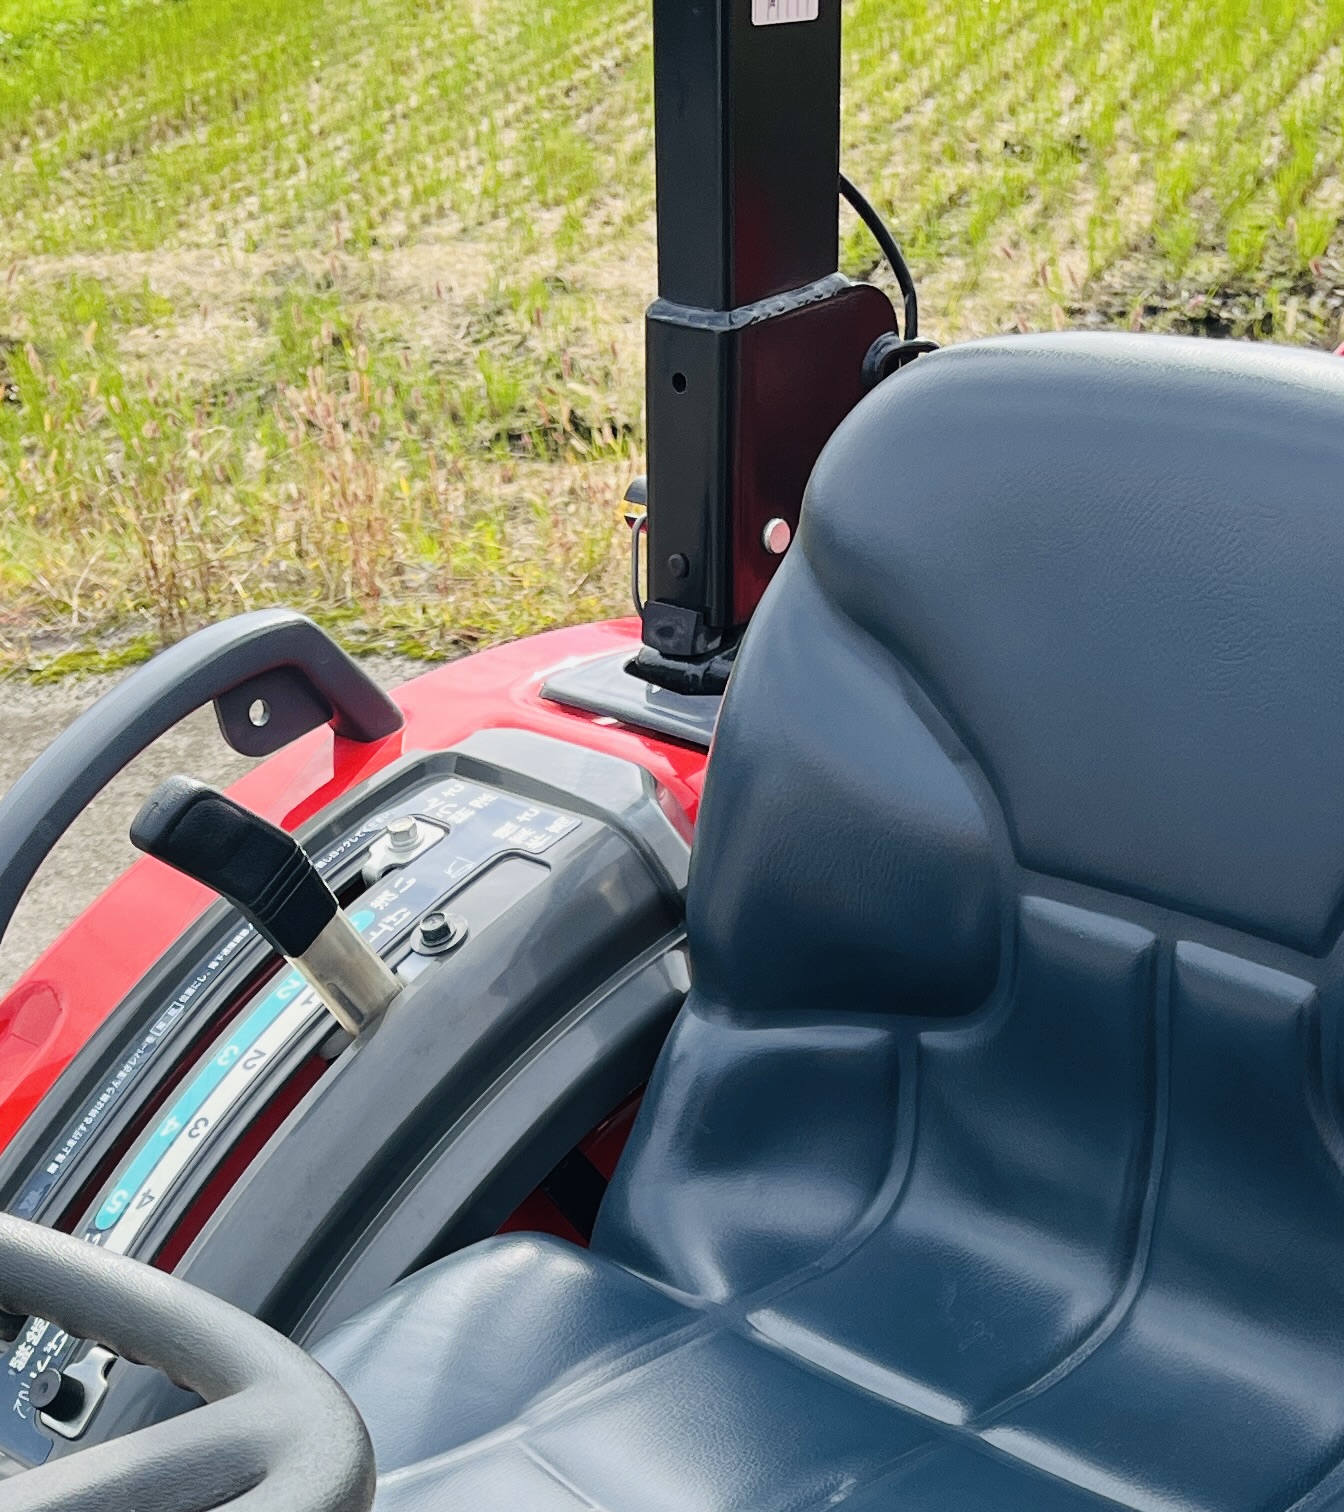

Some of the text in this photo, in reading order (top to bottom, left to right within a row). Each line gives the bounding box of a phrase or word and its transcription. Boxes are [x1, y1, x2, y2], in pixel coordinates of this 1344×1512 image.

[275, 979, 302, 1000] 2
[217, 1045, 239, 1066] 3
[242, 1048, 266, 1071] 2
[160, 1115, 180, 1137] 4
[188, 1117, 209, 1139] 3
[105, 1190, 129, 1214] 5
[135, 1187, 156, 1211] 4
